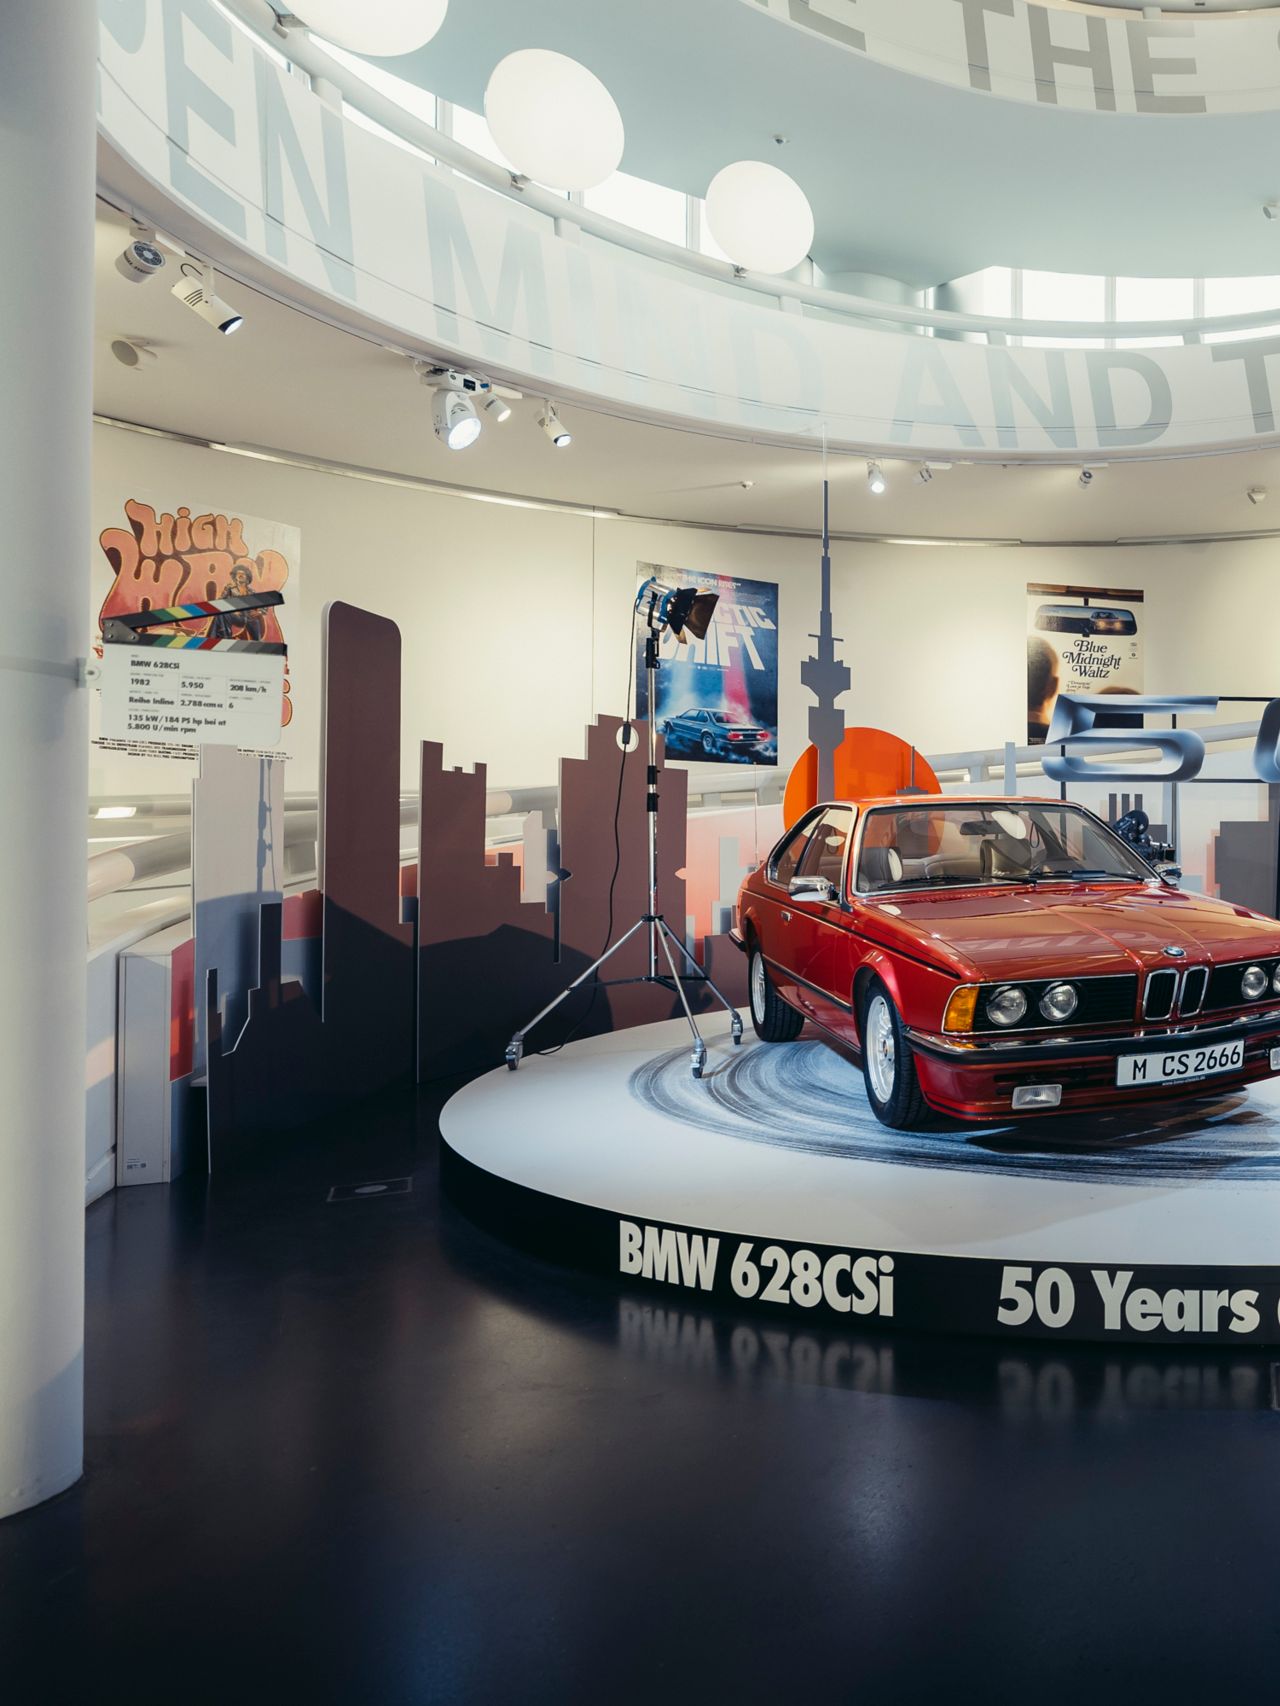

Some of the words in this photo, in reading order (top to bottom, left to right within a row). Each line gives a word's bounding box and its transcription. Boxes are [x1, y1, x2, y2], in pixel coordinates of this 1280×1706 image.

[957, 0, 1207, 113] THE
[889, 344, 1174, 450] AND
[1074, 640, 1108, 653] Blue
[131, 660, 151, 668] BMW
[153, 661, 180, 670] 628CSi
[1062, 652, 1121, 670] Midnight
[1072, 665, 1110, 678] Waltz
[130, 678, 151, 686] 1982
[180, 681, 204, 689] 5.950
[245, 685, 267, 693] km/h
[129, 696, 151, 704] Reihe
[153, 698, 175, 706] Inline
[128, 714, 143, 722] 135
[192, 718, 202, 726] hp
[1132, 1058, 1147, 1081] M
[619, 1220, 720, 1291] BMW
[730, 1242, 895, 1317] 628CSi
[997, 1266, 1076, 1328] 50
[1091, 1270, 1261, 1333] Years
